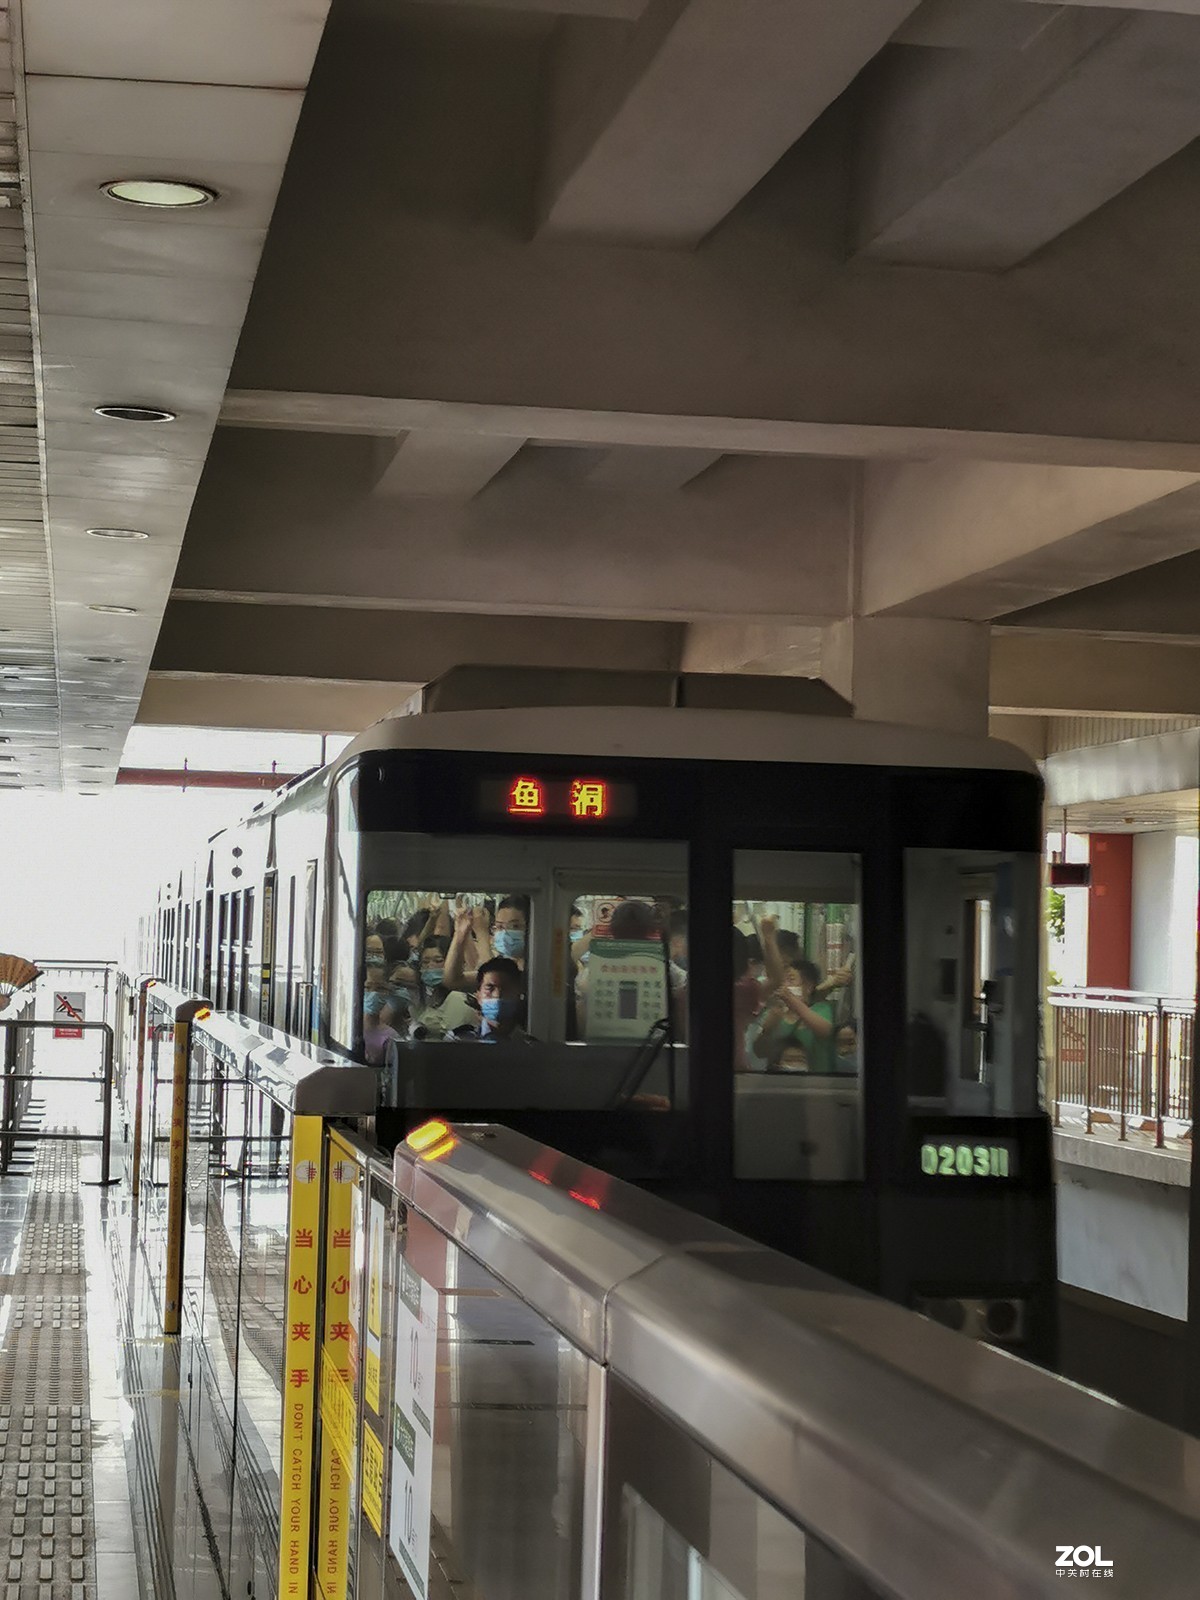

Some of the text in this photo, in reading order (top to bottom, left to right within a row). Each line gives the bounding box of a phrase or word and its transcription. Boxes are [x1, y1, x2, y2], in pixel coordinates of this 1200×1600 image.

[508, 777, 605, 817] 鱼洞
[920, 1144, 1009, 1177] 020311
[290, 1228, 313, 1388] 当心夹手
[288, 1403, 304, 1594] DON'T CATCH YOUR HAND IN
